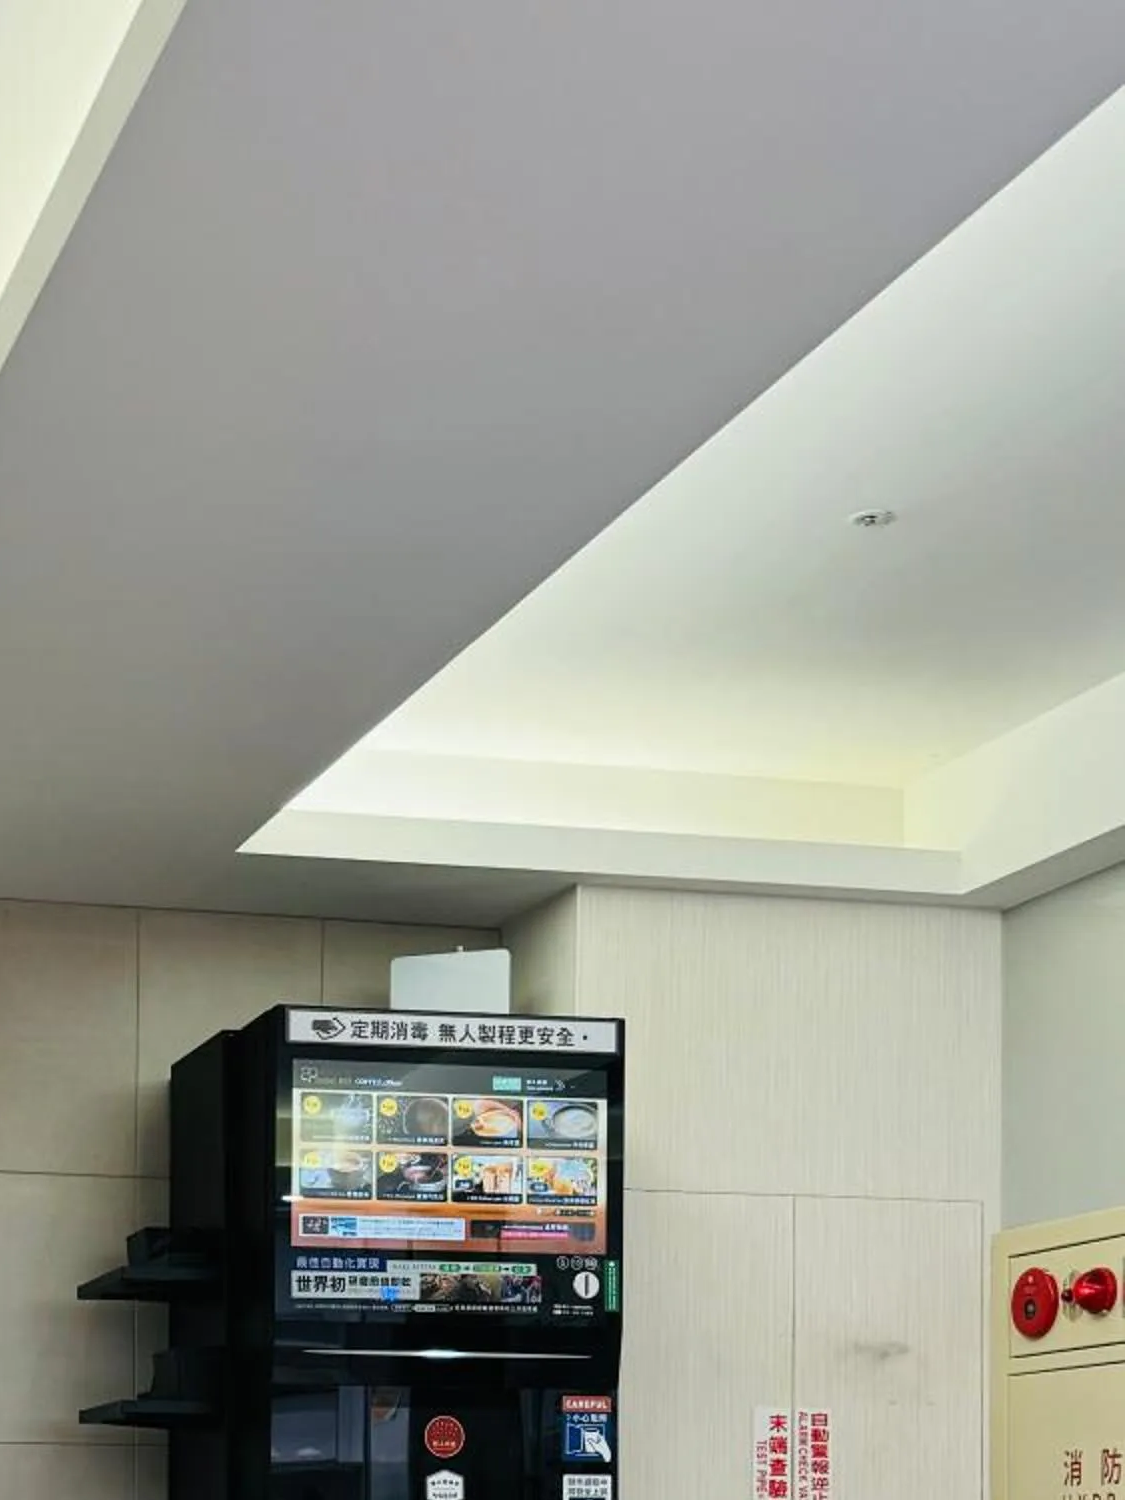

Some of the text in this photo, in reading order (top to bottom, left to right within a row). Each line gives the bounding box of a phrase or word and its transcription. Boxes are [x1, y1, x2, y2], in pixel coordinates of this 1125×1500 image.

[350, 1020, 429, 1042] 定期消毒
[296, 1275, 346, 1293] 世界初
[566, 1400, 608, 1409] CAREFUL
[756, 1440, 767, 1465] TEST
